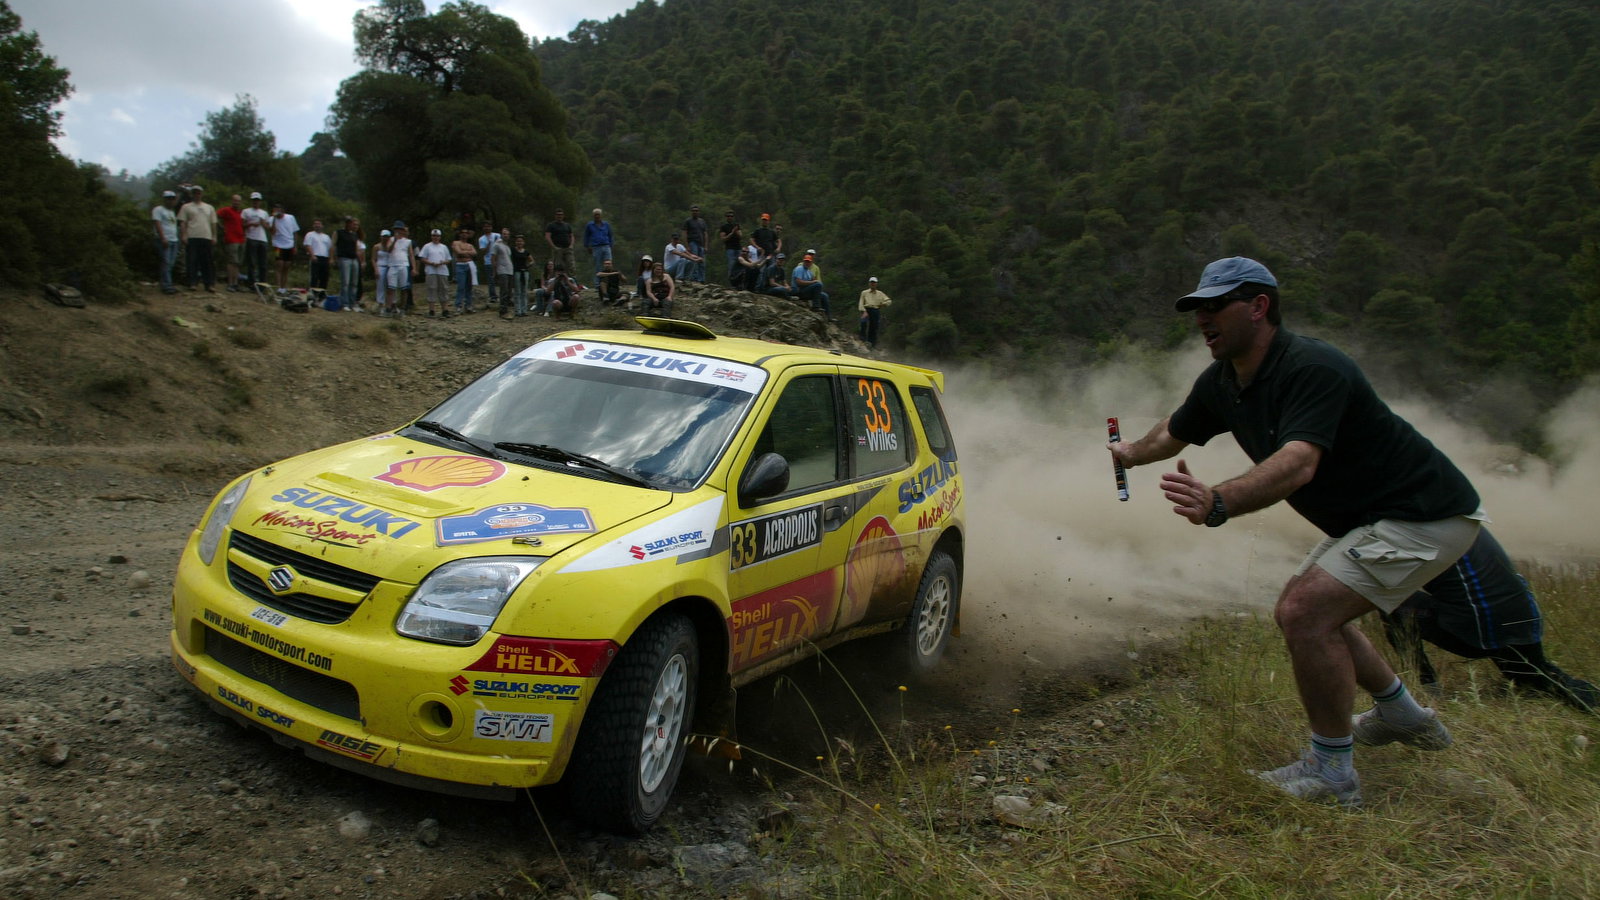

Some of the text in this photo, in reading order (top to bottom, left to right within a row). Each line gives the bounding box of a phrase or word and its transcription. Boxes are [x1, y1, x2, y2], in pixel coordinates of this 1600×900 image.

[583, 349, 708, 375] SUZUKI
[858, 378, 892, 433] 33
[866, 428, 898, 451] Wilks
[271, 487, 422, 539] SUZUKI
[644, 530, 703, 551] SUZUKI SPORT
[732, 509, 818, 569] 33 ACROPOLIS
[732, 602, 771, 629] Shell
[204, 608, 333, 671] www.suzuki-motorsport.com
[731, 597, 820, 664] HELIX
[496, 649, 581, 674] HELIX
[497, 645, 529, 654] Shell
[474, 680, 581, 695] SUZUKI SPORT
[499, 692, 554, 700] EUROPE
[218, 686, 296, 729] SUZUKI SPORT
[477, 716, 550, 739] SWT
